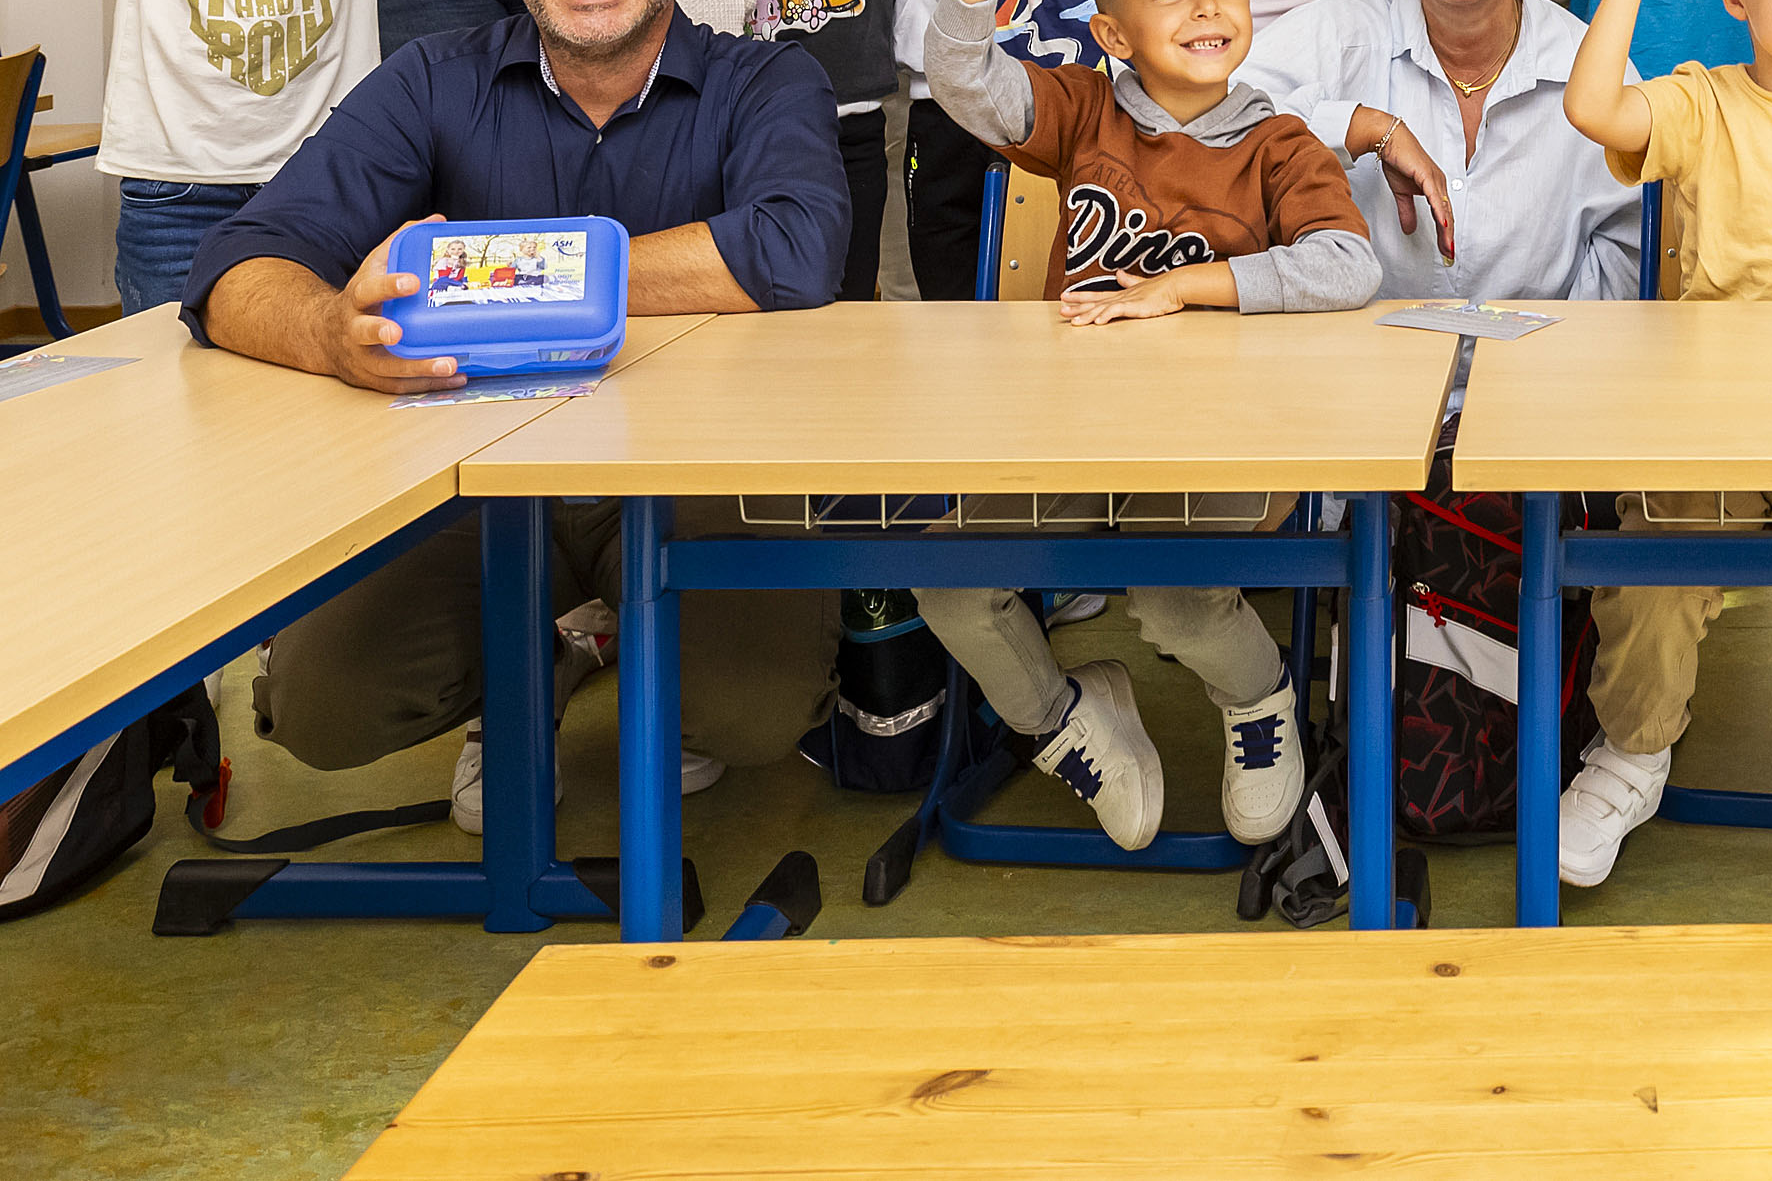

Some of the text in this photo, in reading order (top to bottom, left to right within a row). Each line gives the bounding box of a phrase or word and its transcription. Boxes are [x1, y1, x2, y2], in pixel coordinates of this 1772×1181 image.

[204, 12, 334, 97] ROLL
[552, 240, 573, 248] ASH
[1065, 184, 1215, 276] Dino
